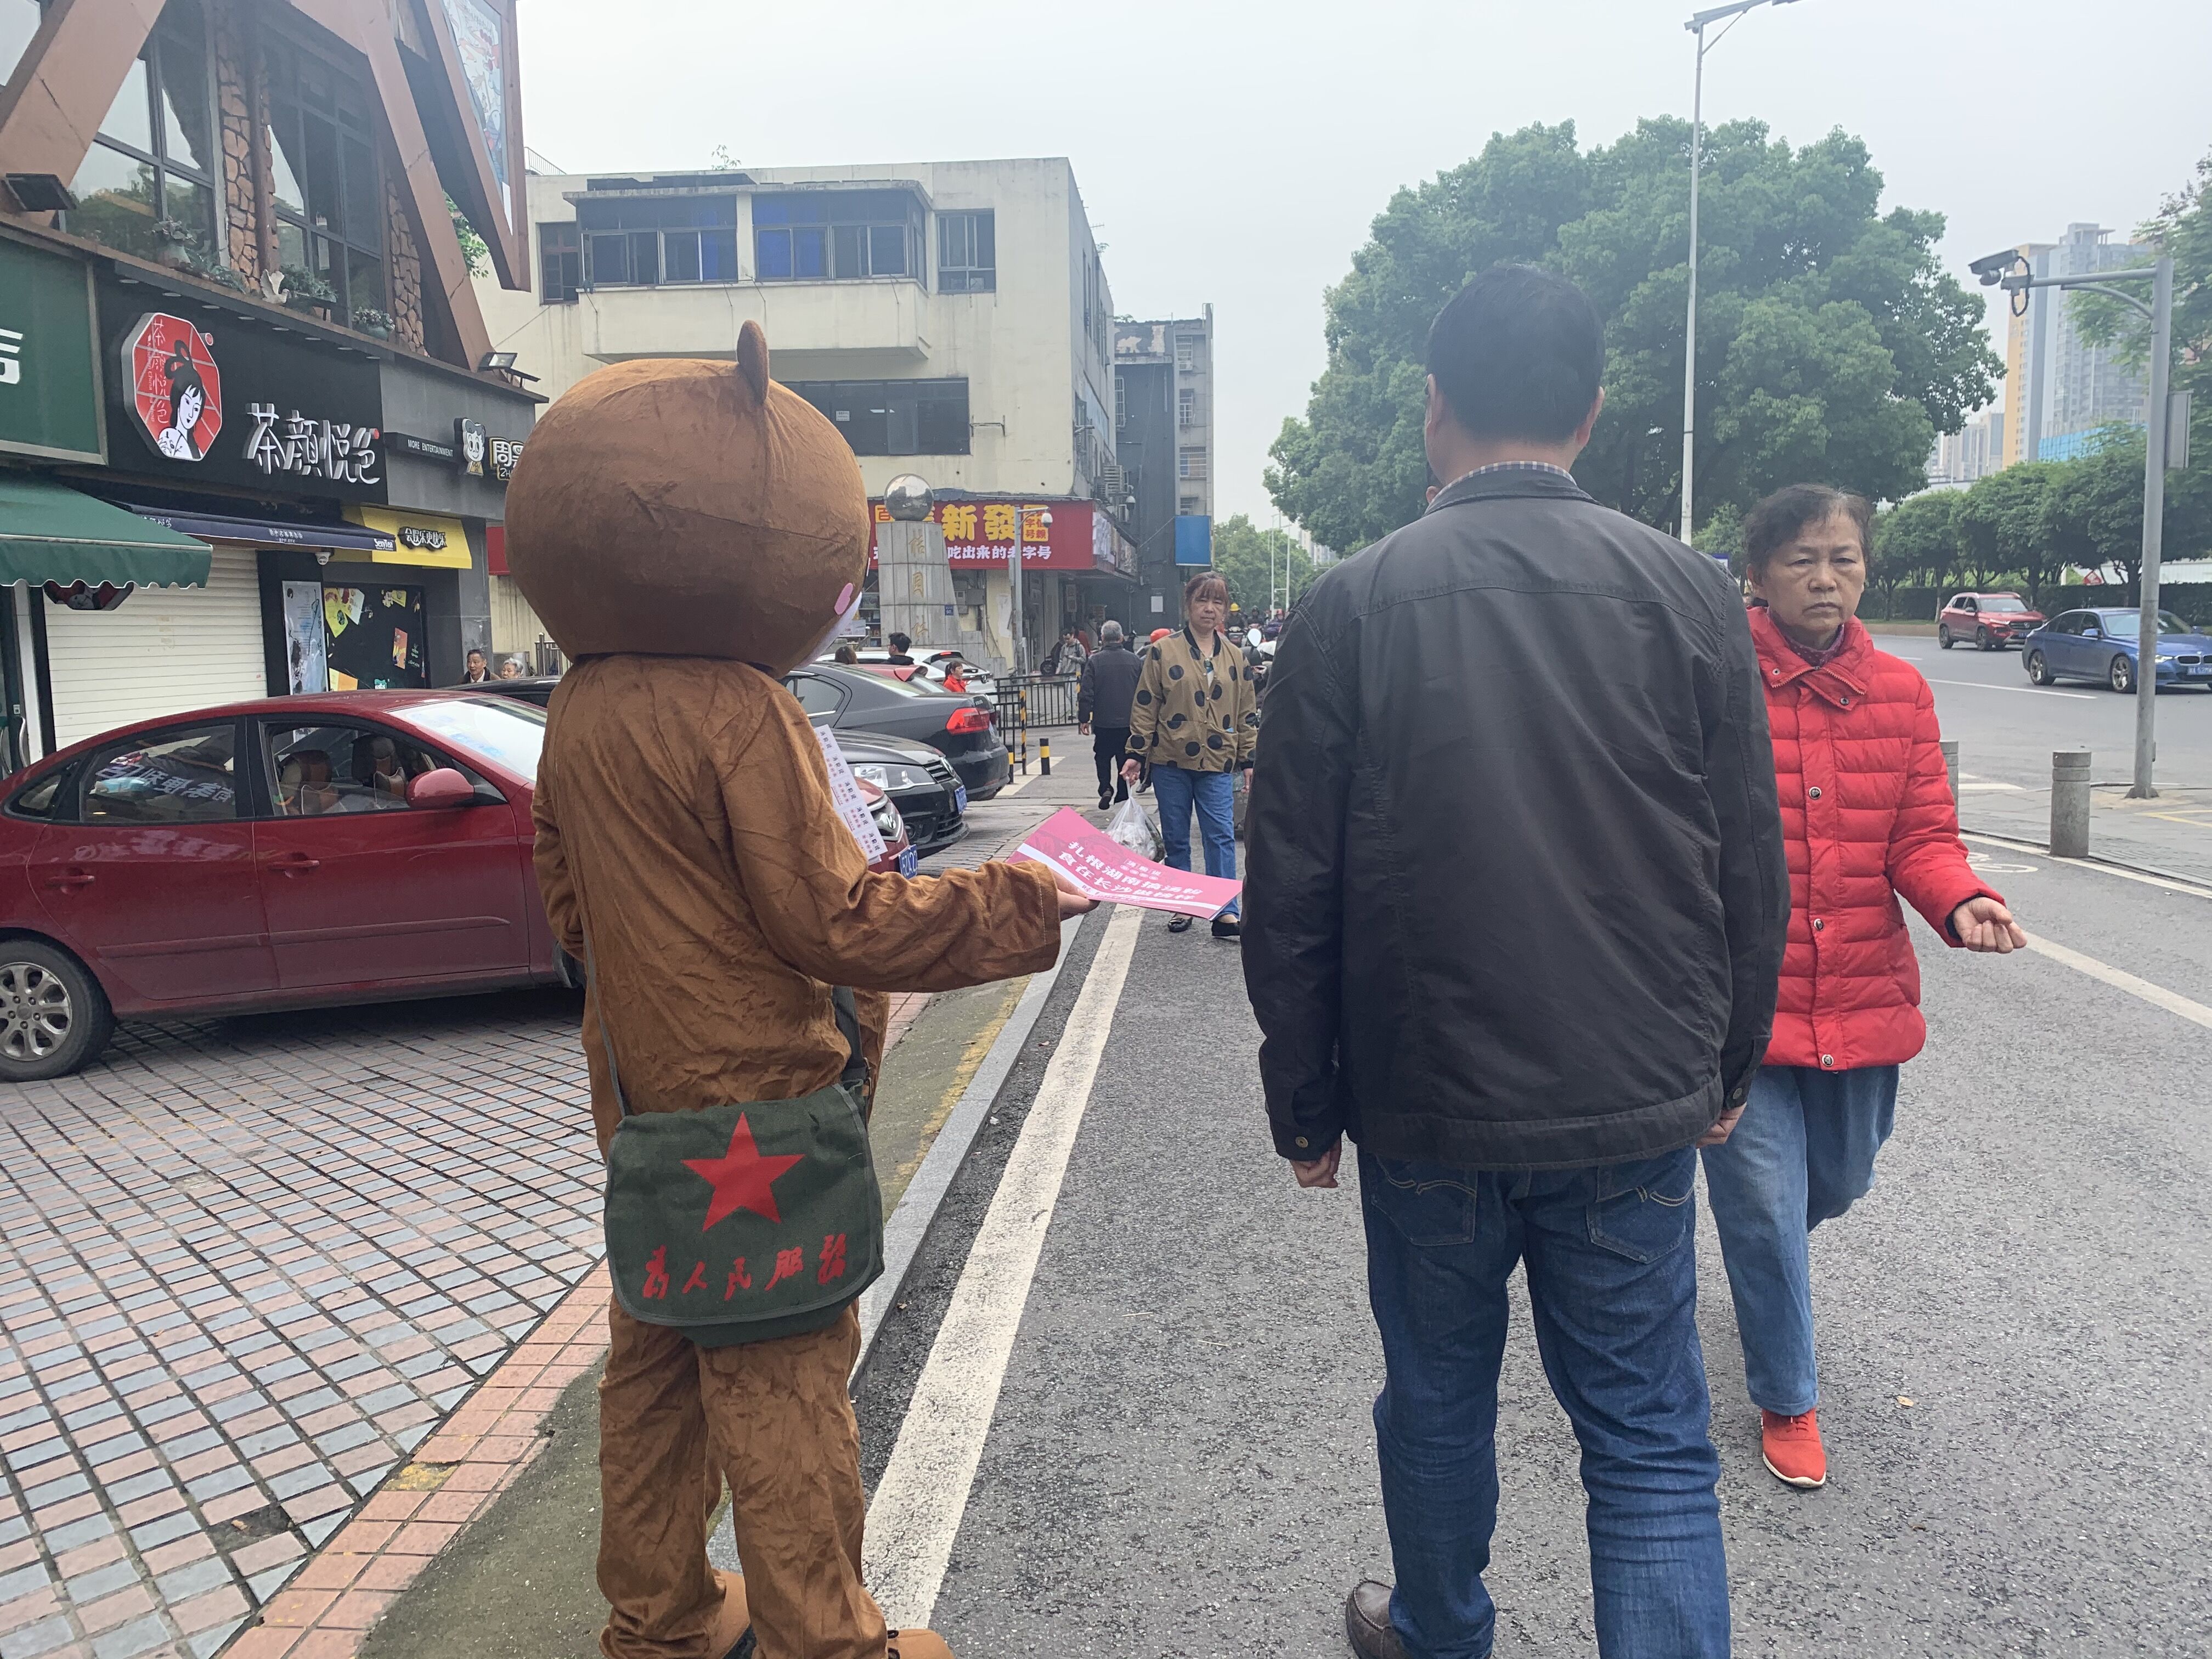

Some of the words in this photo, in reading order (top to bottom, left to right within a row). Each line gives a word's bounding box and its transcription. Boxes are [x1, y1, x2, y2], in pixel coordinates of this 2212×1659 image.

[408, 439, 420, 449] MORE
[422, 443, 454, 457] ENTERTAINMENT
[924, 504, 1015, 541] 新發
[405, 528, 446, 549] 会娱乐更快乐
